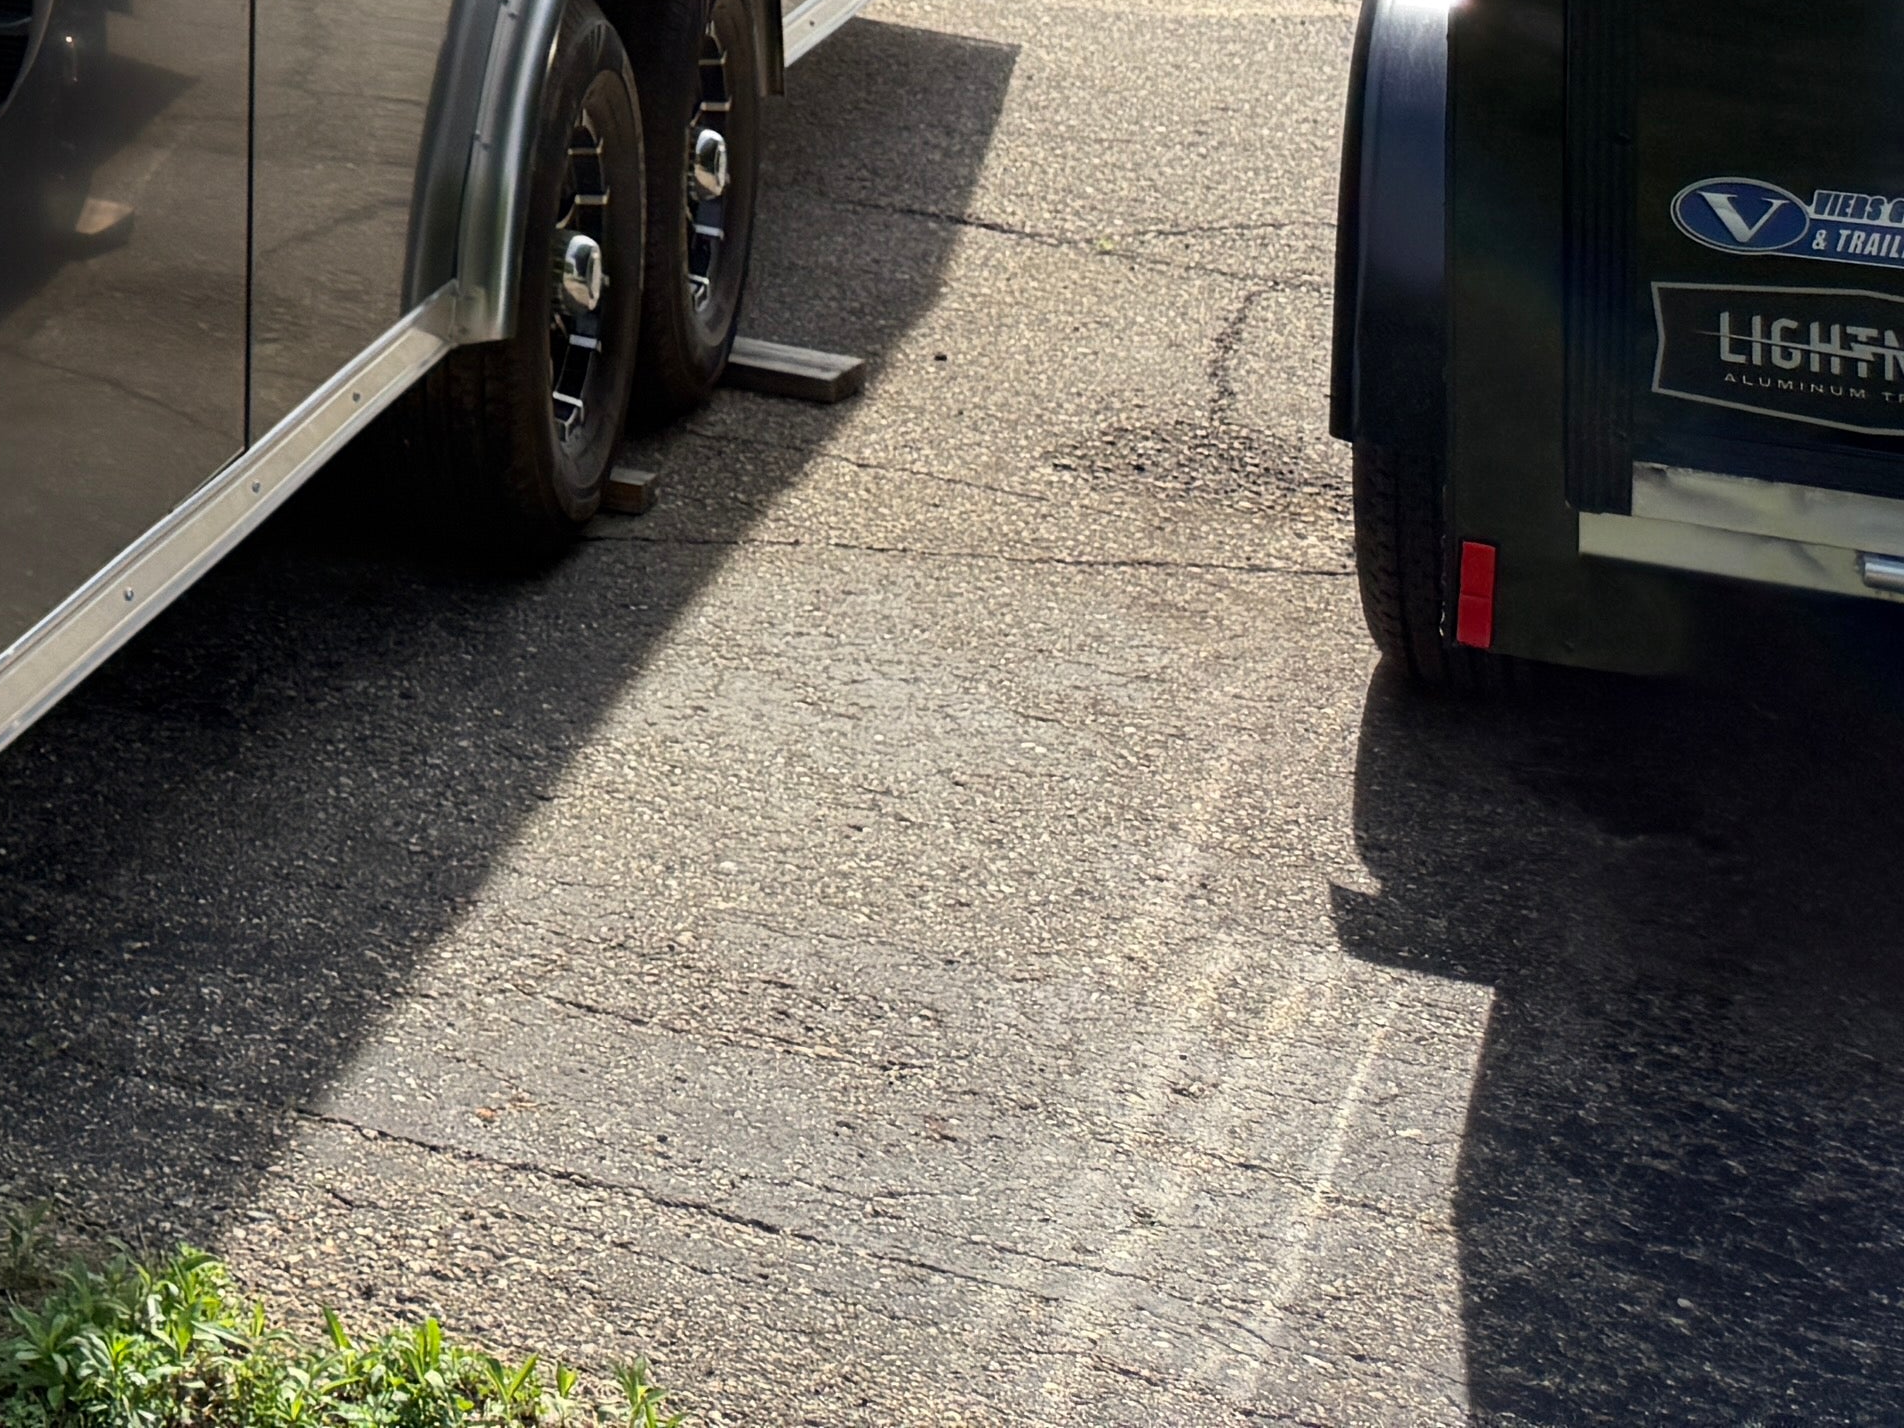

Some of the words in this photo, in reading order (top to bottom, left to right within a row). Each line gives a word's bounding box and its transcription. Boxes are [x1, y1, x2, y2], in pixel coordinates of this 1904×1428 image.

[1696, 191, 1790, 243] V
[1812, 229, 1827, 250] &
[1836, 229, 1904, 259] TRAIL
[1720, 311, 1904, 382] LIGHTN
[1724, 372, 1867, 399] ALUMINUM
